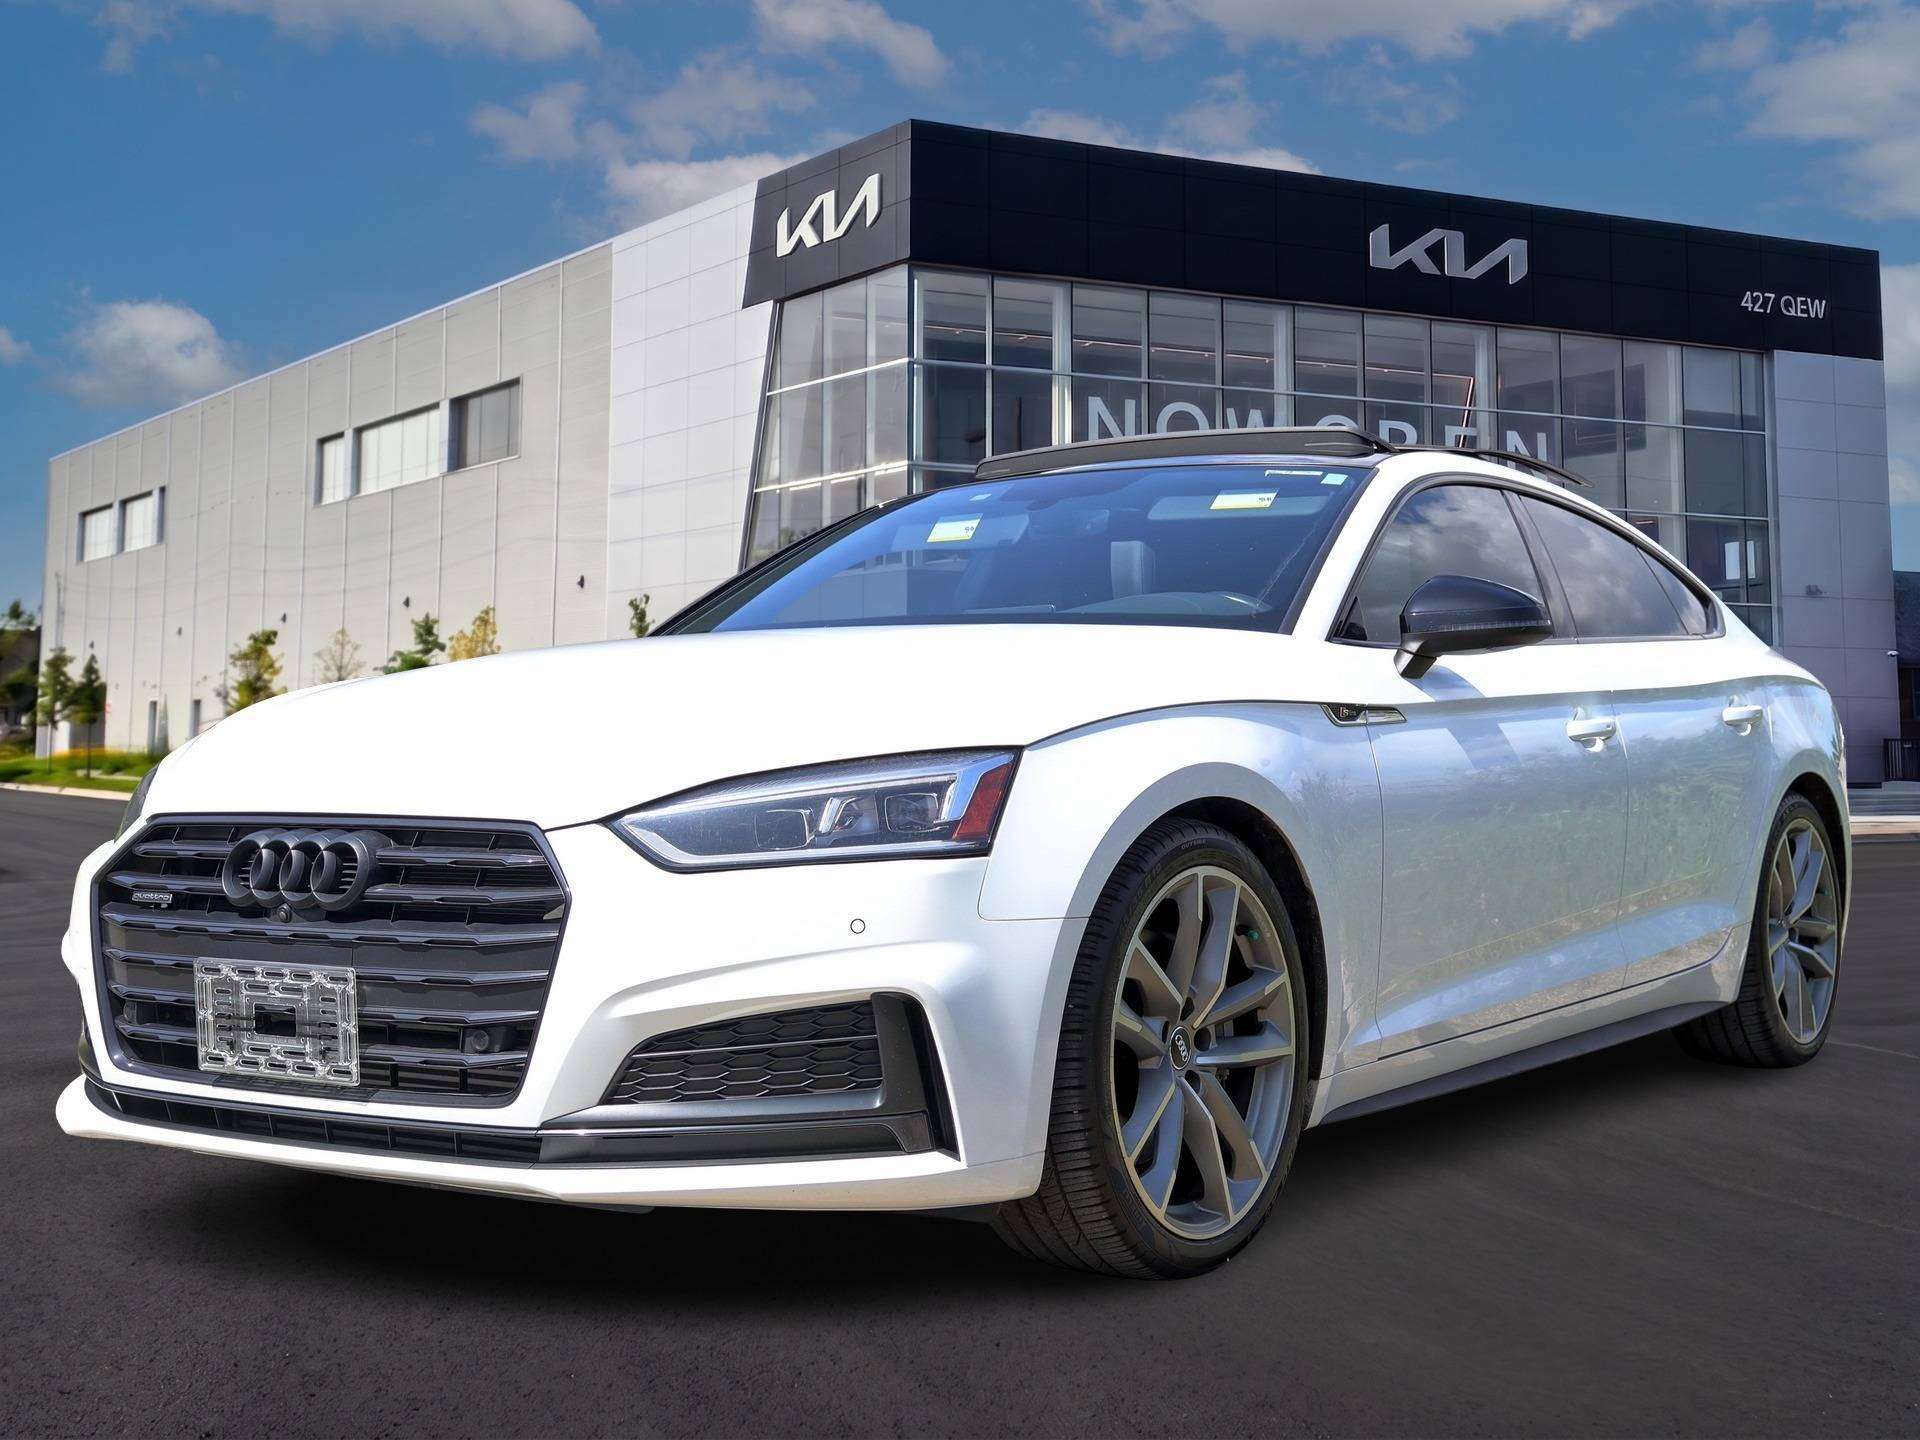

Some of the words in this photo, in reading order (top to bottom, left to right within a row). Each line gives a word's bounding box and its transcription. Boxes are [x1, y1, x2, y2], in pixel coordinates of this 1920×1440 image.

[777, 173, 880, 258] KIA
[1369, 223, 1529, 285] KIA
[1740, 291, 1776, 313] 427
[1780, 295, 1826, 319] QEW
